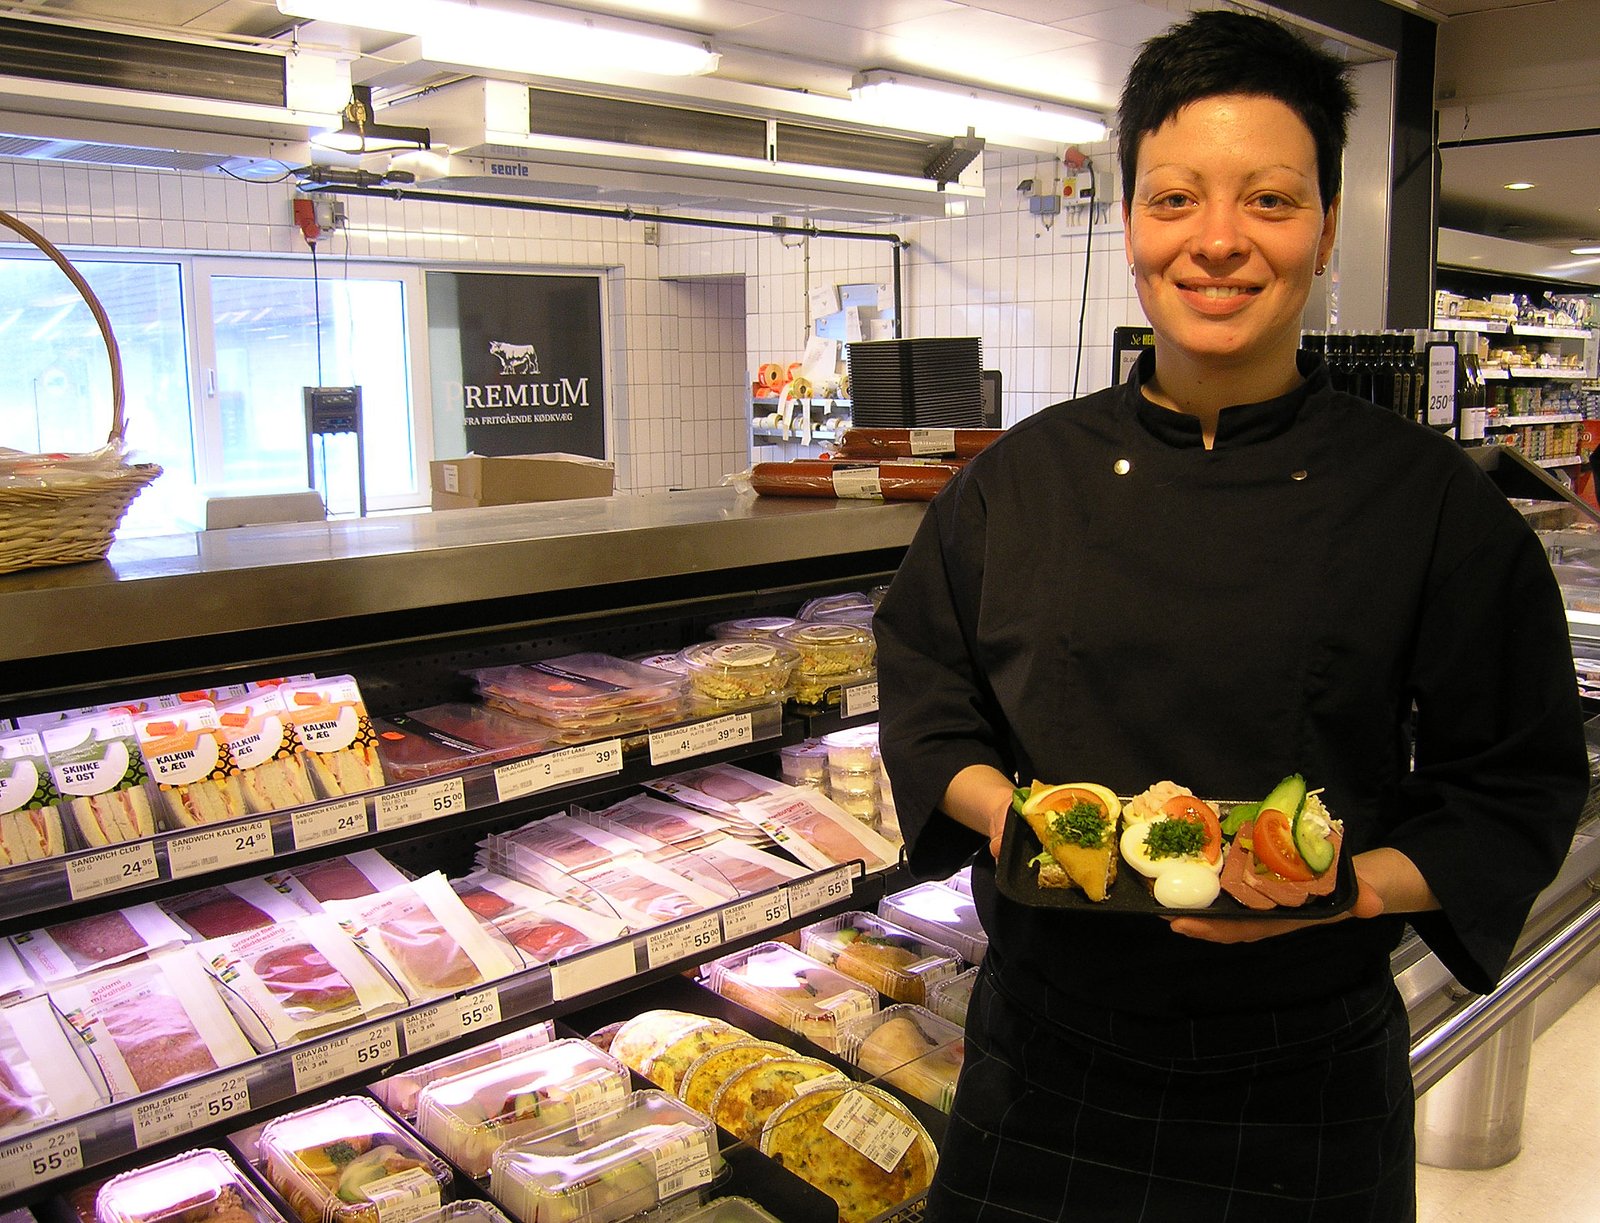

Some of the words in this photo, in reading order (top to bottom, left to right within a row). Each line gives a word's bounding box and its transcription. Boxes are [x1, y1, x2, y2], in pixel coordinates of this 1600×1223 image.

[491, 163, 529, 177] searle
[442, 378, 590, 412] PREMIUM
[464, 417, 481, 426] FRA
[482, 414, 533, 425] FRITGÅENDE
[533, 413, 573, 423] KØDKVÆG
[302, 721, 338, 733] KALKUN
[229, 734, 261, 750] ALKUN
[306, 733, 314, 741] &
[316, 731, 330, 739] ÆG
[155, 750, 196, 765] KALKUN
[238, 746, 253, 757] ÆG
[62, 762, 100, 775] SKINKE
[160, 765, 168, 774] &
[171, 762, 187, 771] ÆG
[65, 774, 74, 784] &
[76, 772, 96, 782] OST
[381, 789, 418, 801] ROASTBEEF
[295, 808, 325, 820] SANDWICH
[172, 831, 215, 848] SANDWICH
[216, 822, 263, 838] KALKUN/ÆG
[71, 851, 118, 868] SANDWICH
[119, 845, 141, 857] CLUB
[91, 978, 122, 997] Salami
[405, 1007, 439, 1024] SALTKØD
[295, 1045, 329, 1061] GRAVAD
[330, 1037, 350, 1050] FILET
[155, 1116, 161, 1124] 3
[162, 1112, 175, 1121] stk
